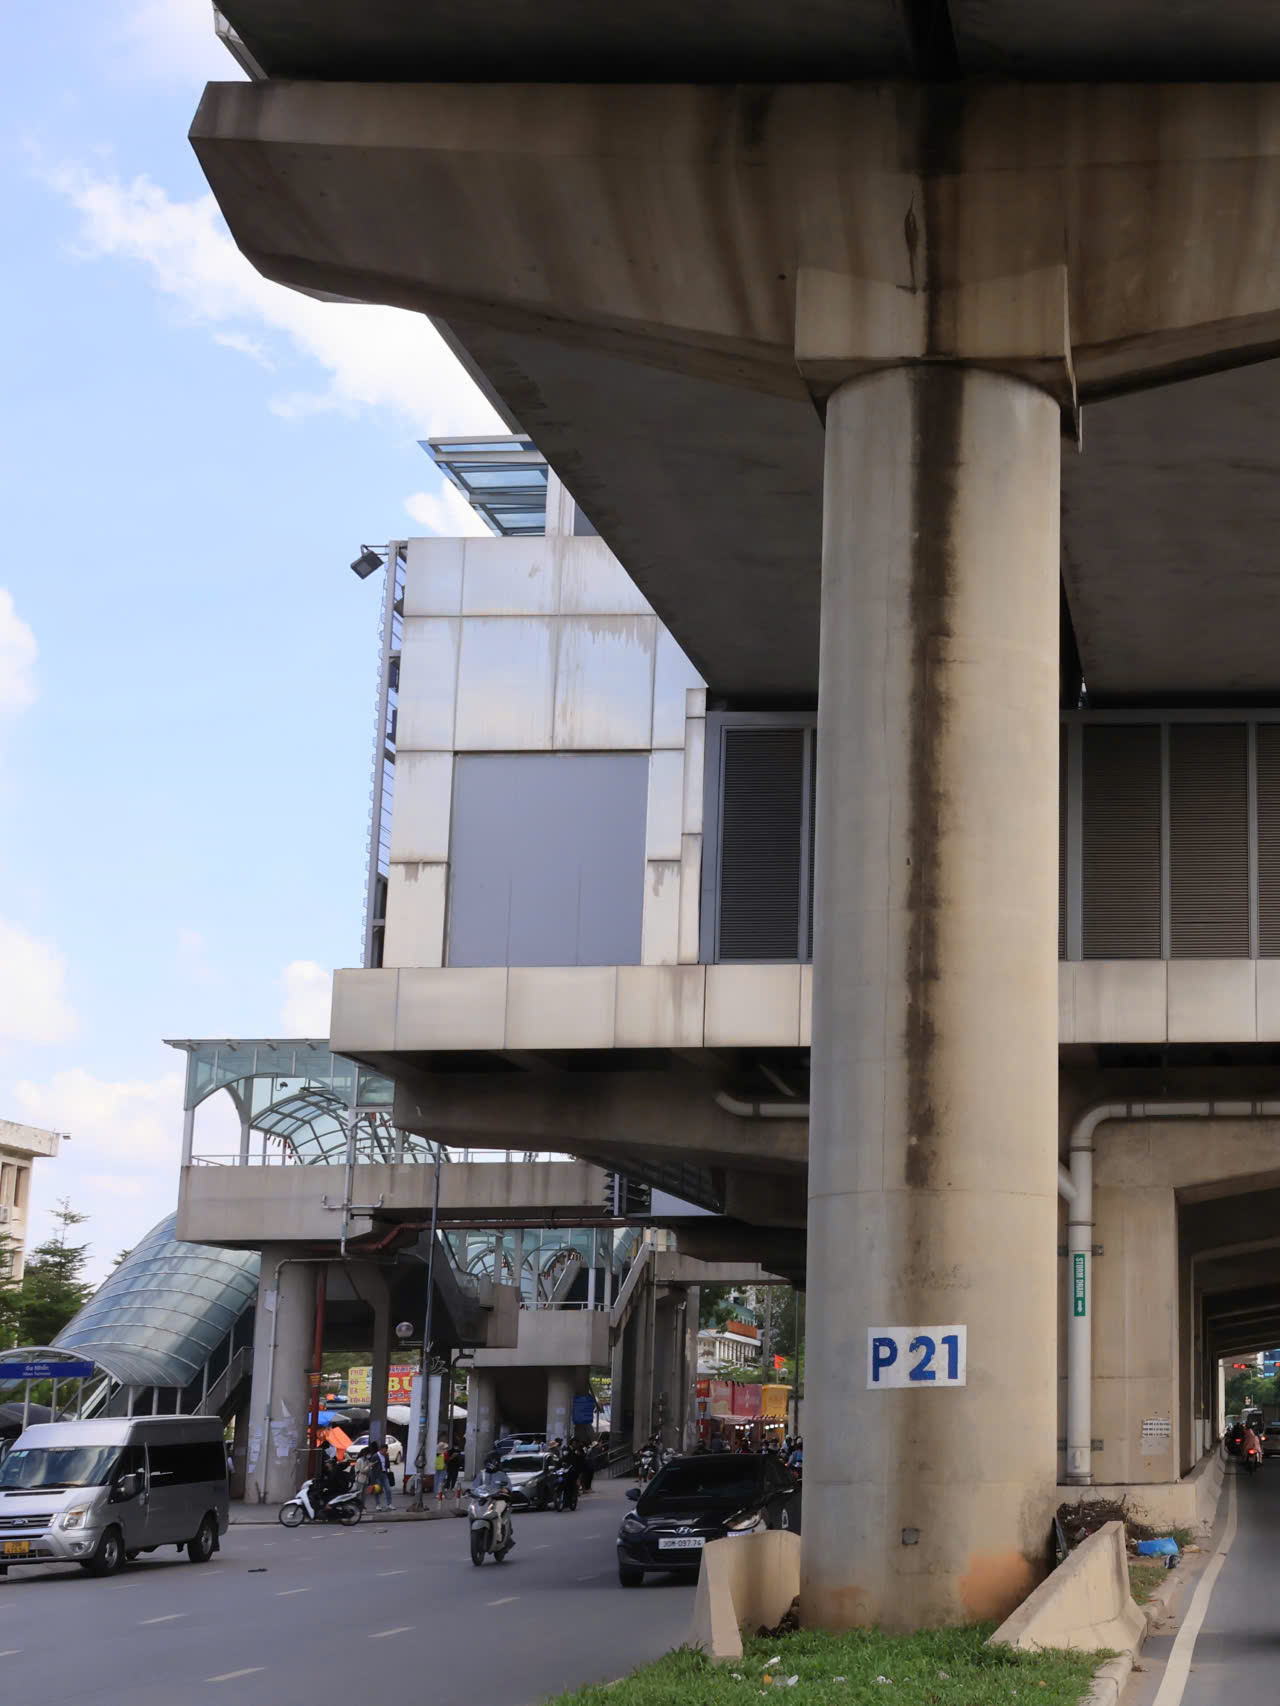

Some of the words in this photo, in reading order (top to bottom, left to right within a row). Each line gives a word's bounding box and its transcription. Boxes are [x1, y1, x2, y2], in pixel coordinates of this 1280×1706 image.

[1075, 1257, 1084, 1278] STORM
[1075, 1279, 1084, 1298] DRAIN
[872, 1337, 898, 1382] P
[909, 1335, 959, 1381] 21
